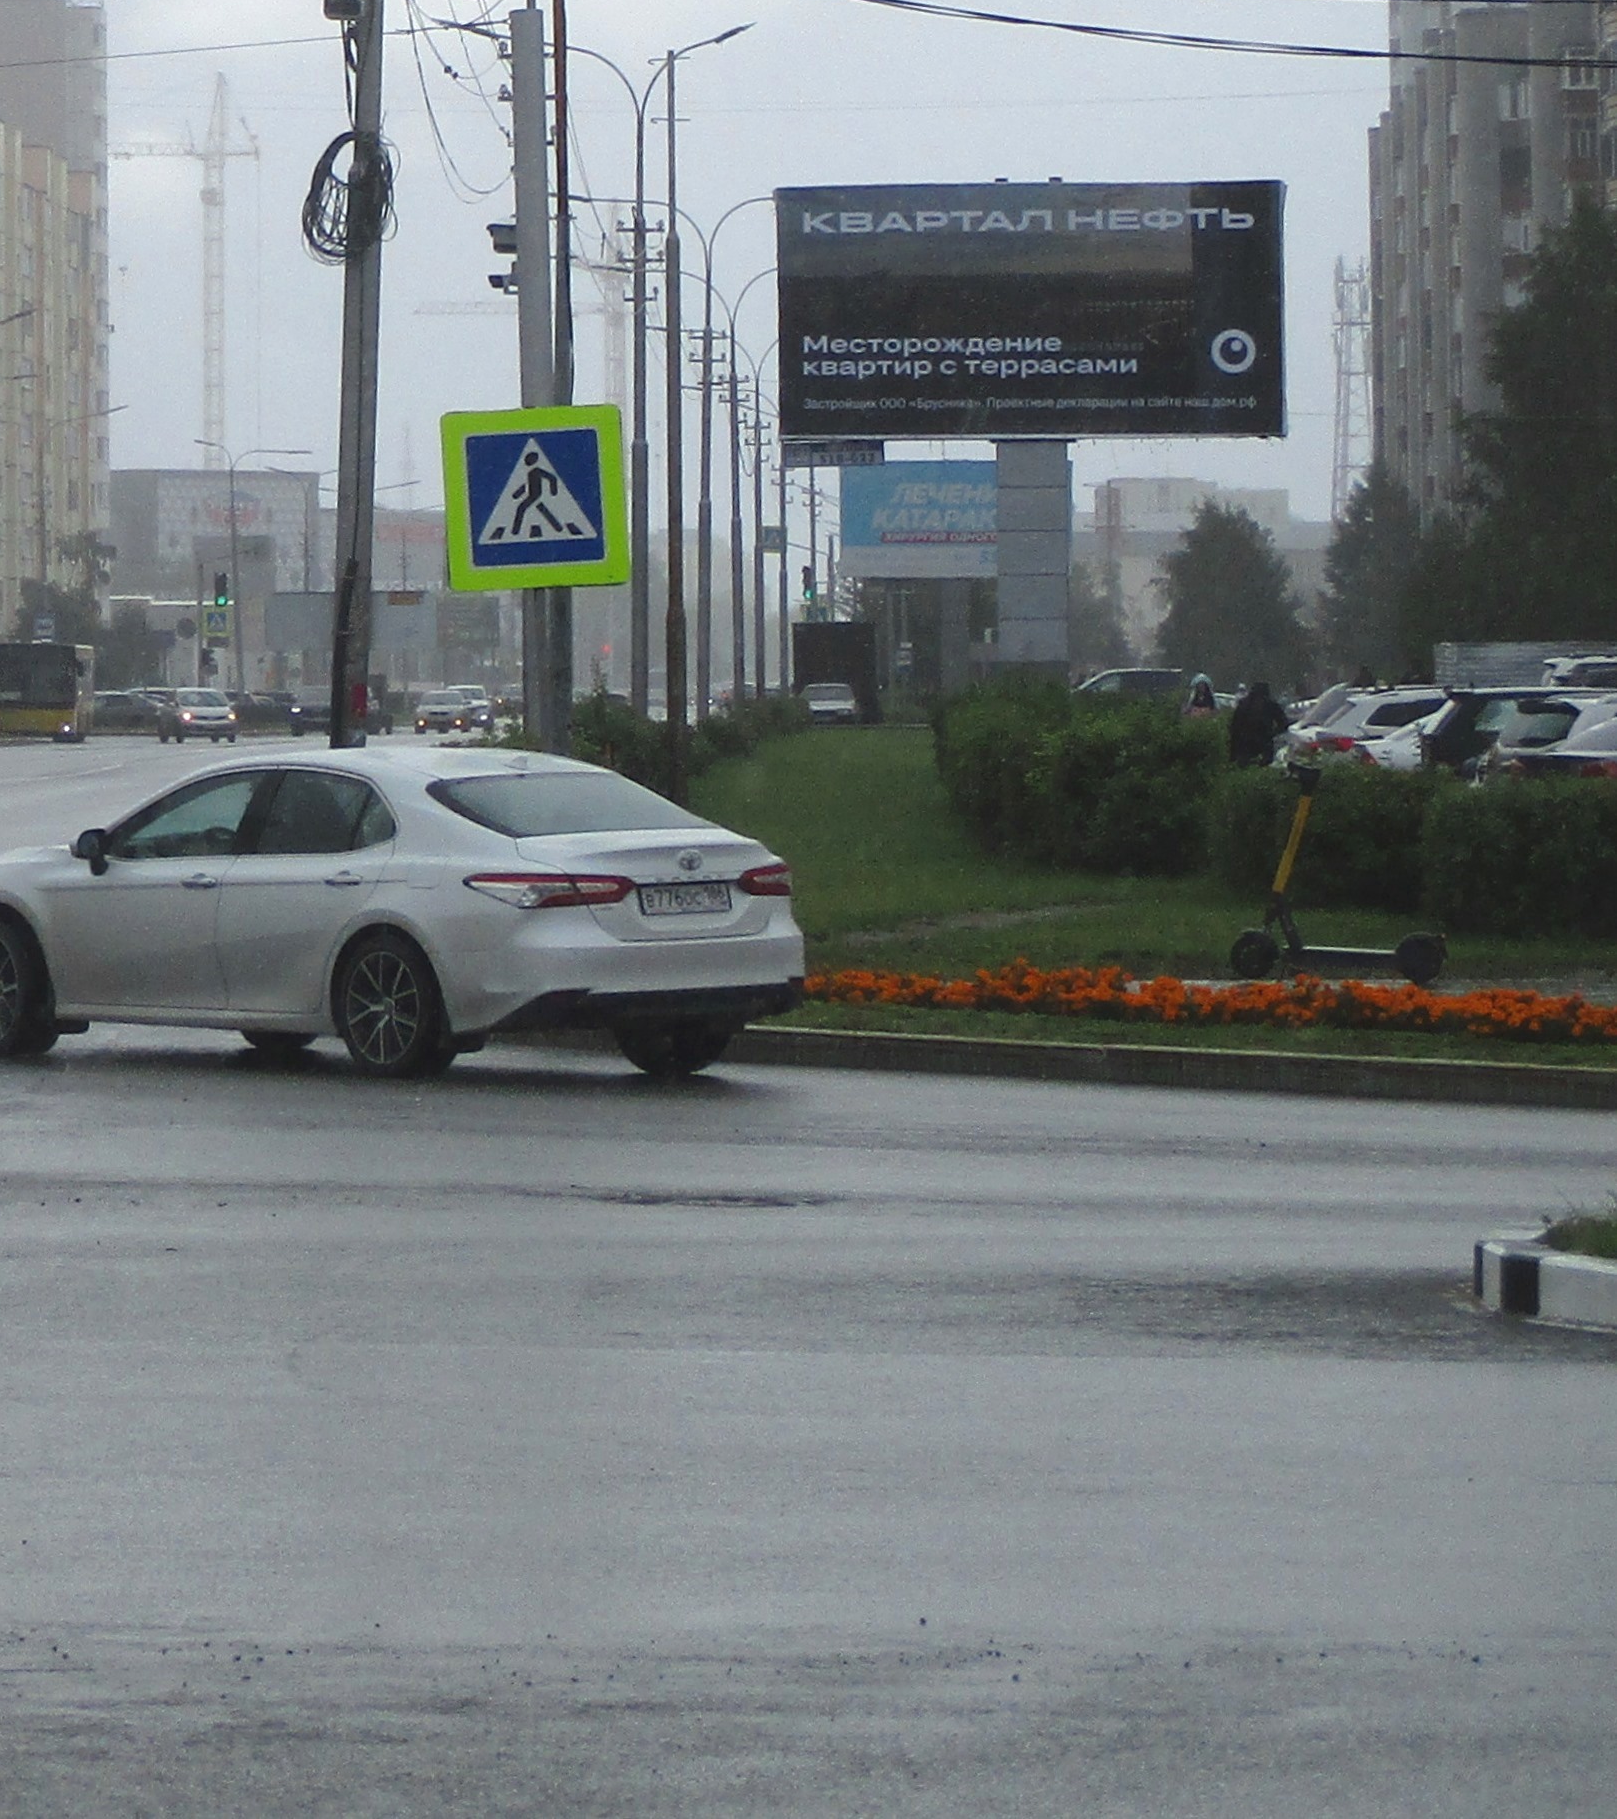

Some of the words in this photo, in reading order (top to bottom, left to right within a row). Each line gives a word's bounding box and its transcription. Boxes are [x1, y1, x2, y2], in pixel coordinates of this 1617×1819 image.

[801, 209, 1053, 234] КВАРТАЛ
[1069, 207, 1255, 231] НЕФТЬ
[801, 335, 1063, 357] Месторождение
[802, 359, 933, 379] квартир
[939, 360, 958, 375] с
[964, 358, 1139, 378] террасами
[803, 398, 876, 411] Застройщик
[880, 398, 907, 409] ООО
[987, 397, 1054, 410] Проектные
[1055, 398, 1129, 409] декларации
[1131, 398, 1145, 407] на
[1147, 396, 1182, 408] сайте
